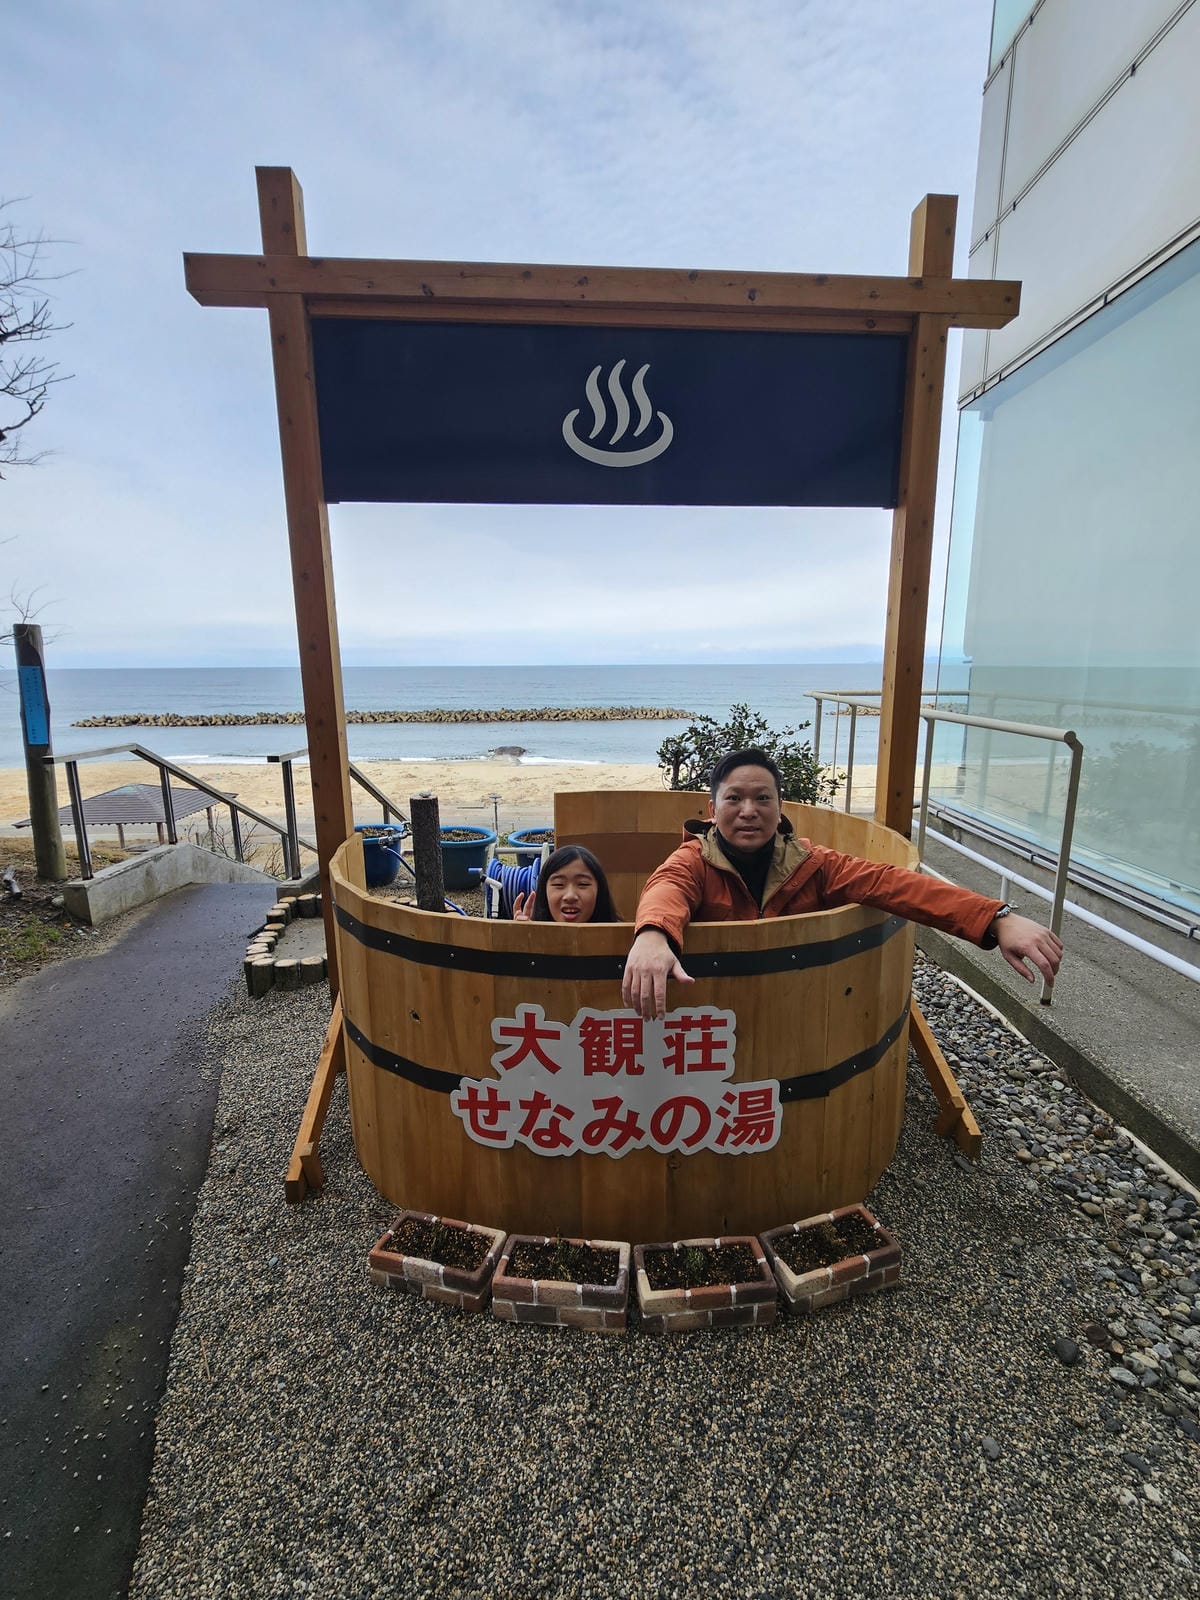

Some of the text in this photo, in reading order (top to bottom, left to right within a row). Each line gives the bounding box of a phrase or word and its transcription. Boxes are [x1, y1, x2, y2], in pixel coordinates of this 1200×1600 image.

[500, 1012, 728, 1076] 大観荘
[457, 1086, 776, 1150] せなみの湯
